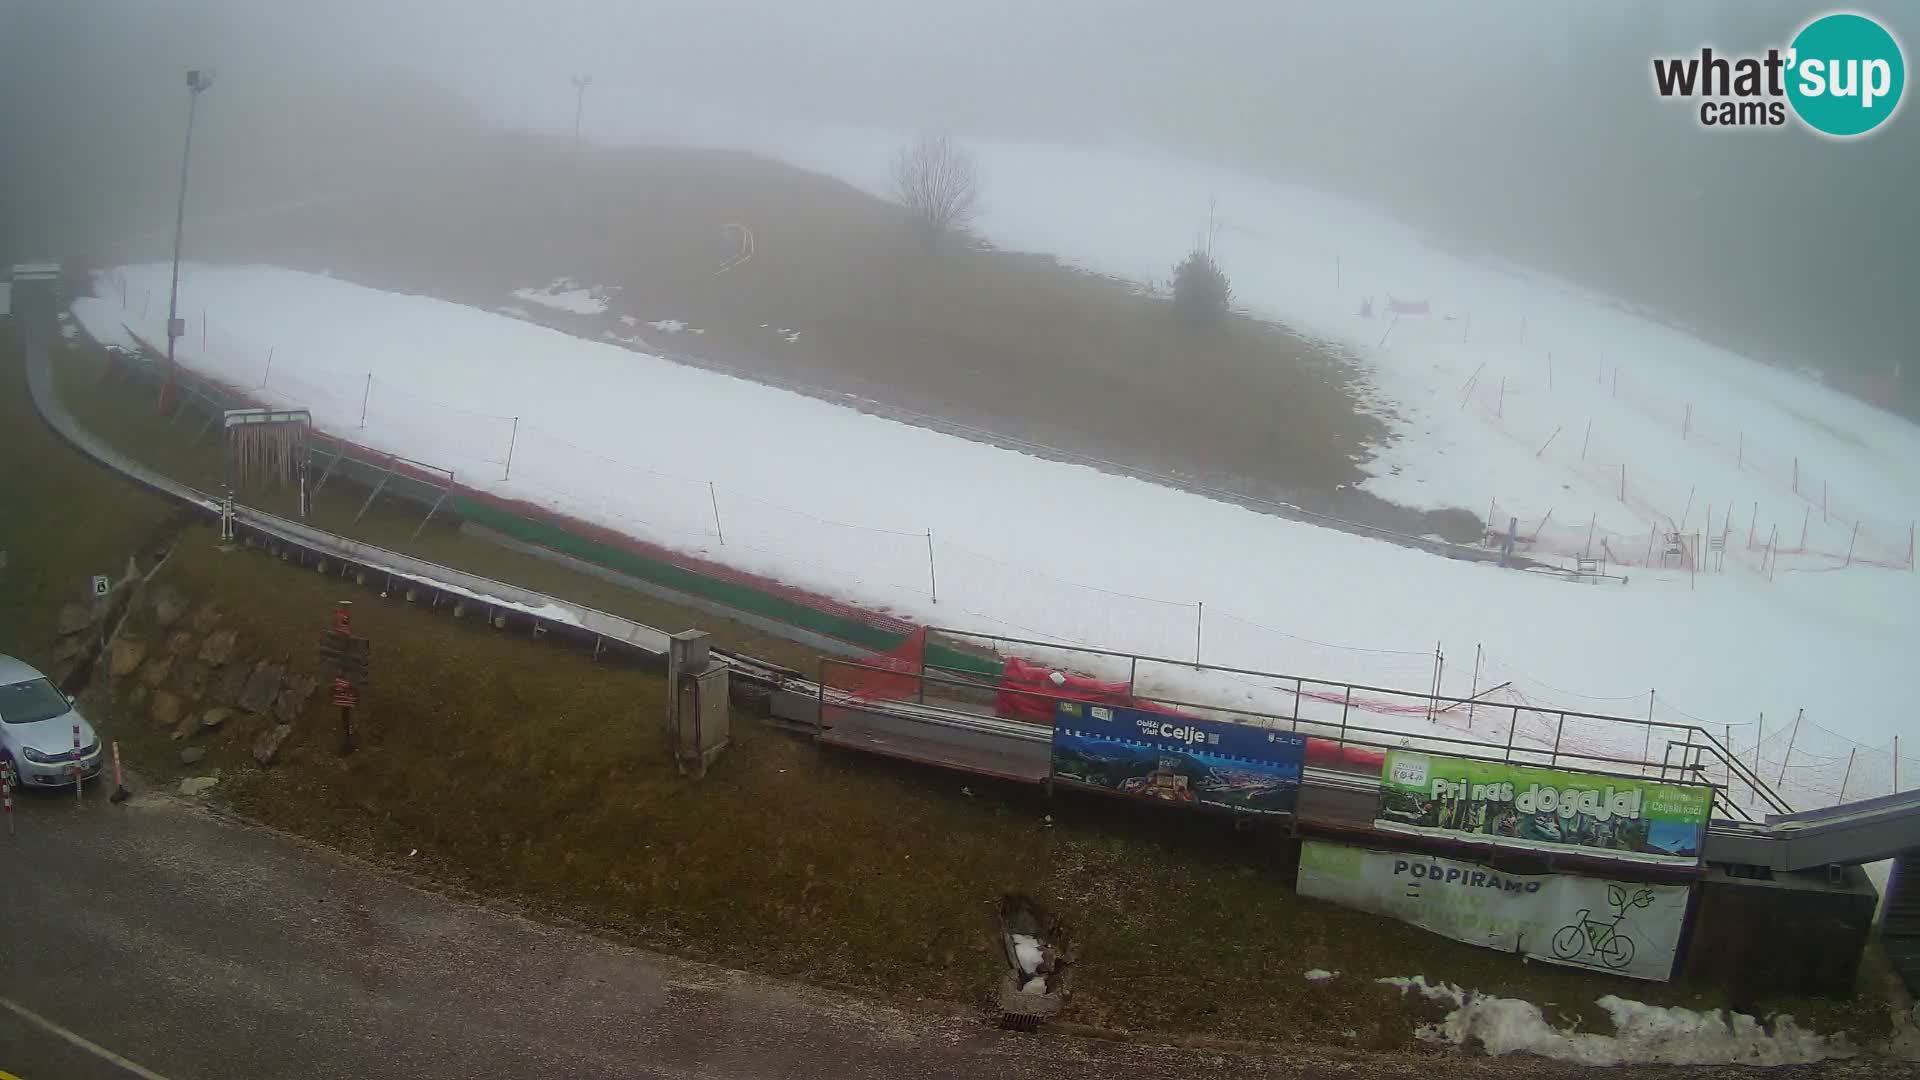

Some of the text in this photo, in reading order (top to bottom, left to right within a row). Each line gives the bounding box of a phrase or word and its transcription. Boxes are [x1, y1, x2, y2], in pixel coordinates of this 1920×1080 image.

[1142, 727, 1159, 736] Visit
[1160, 723, 1206, 745] Celje
[1431, 778, 1467, 801] Pri
[1472, 782, 1514, 802] nas
[1515, 783, 1643, 822] dogaja!
[1393, 859, 1541, 895] PODPIRAMO
